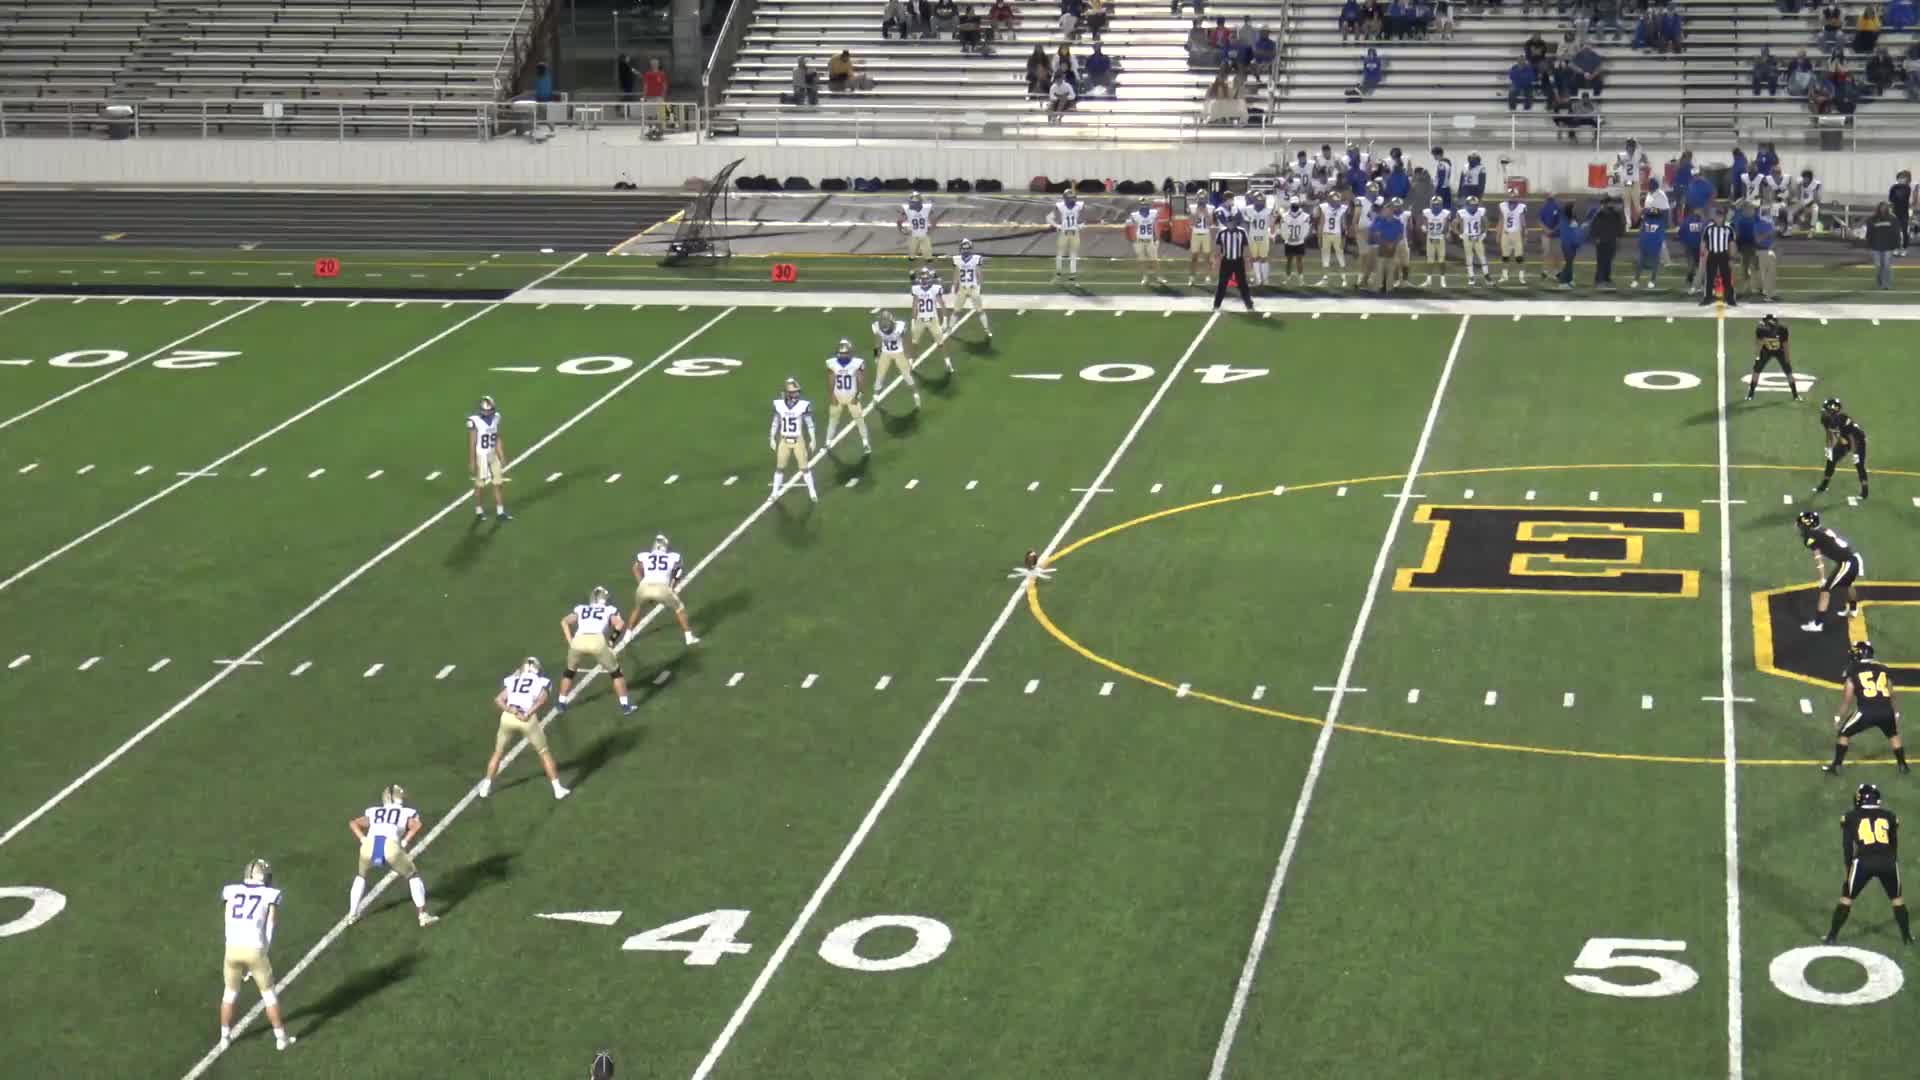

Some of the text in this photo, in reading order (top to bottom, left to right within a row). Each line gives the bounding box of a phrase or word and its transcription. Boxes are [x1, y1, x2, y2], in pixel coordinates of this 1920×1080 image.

[319, 260, 335, 273] 20
[775, 264, 792, 279] 30
[959, 269, 974, 282] 23
[918, 299, 933, 312] 20
[836, 374, 852, 390] 50
[782, 417, 797, 432] 15
[480, 433, 497, 449] 89
[647, 555, 668, 571] 35
[580, 607, 605, 620] 82
[512, 678, 533, 694] 12
[1857, 671, 1889, 698] 54
[374, 808, 400, 825] 80
[1857, 817, 1889, 845] 46
[232, 894, 262, 920] 27
